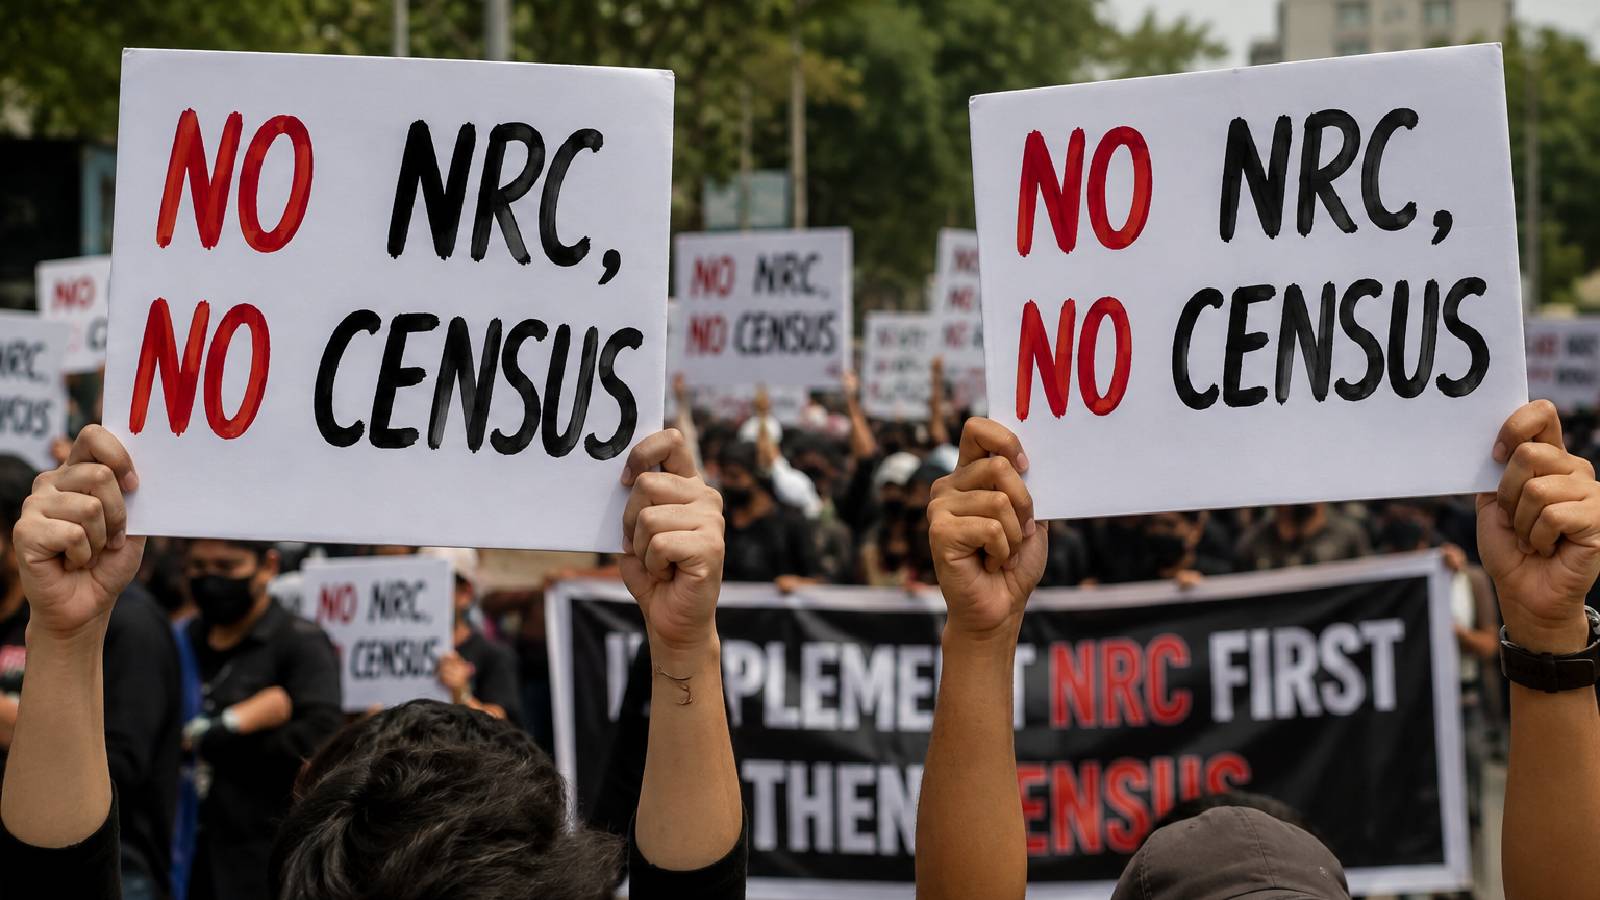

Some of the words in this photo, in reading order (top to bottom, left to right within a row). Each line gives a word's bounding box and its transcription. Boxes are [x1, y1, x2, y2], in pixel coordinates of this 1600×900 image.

[156, 107, 314, 254] NO
[386, 119, 622, 286] NRC,
[1016, 125, 1153, 258] NO
[1219, 107, 1454, 246] NRC,
[52, 275, 96, 311] NO
[689, 254, 736, 298] NO
[129, 296, 271, 441] NO
[313, 308, 644, 461] CENSUS
[685, 314, 728, 358] NO
[733, 309, 838, 356] CENSUS
[1015, 295, 1133, 422] NO
[1171, 276, 1491, 411] CENSUS
[316, 582, 358, 626] NO
[350, 637, 440, 680] CENSUS
[1048, 633, 1193, 730] NRC
[1208, 618, 1405, 723] FIRST
[741, 758, 924, 857] THEN
